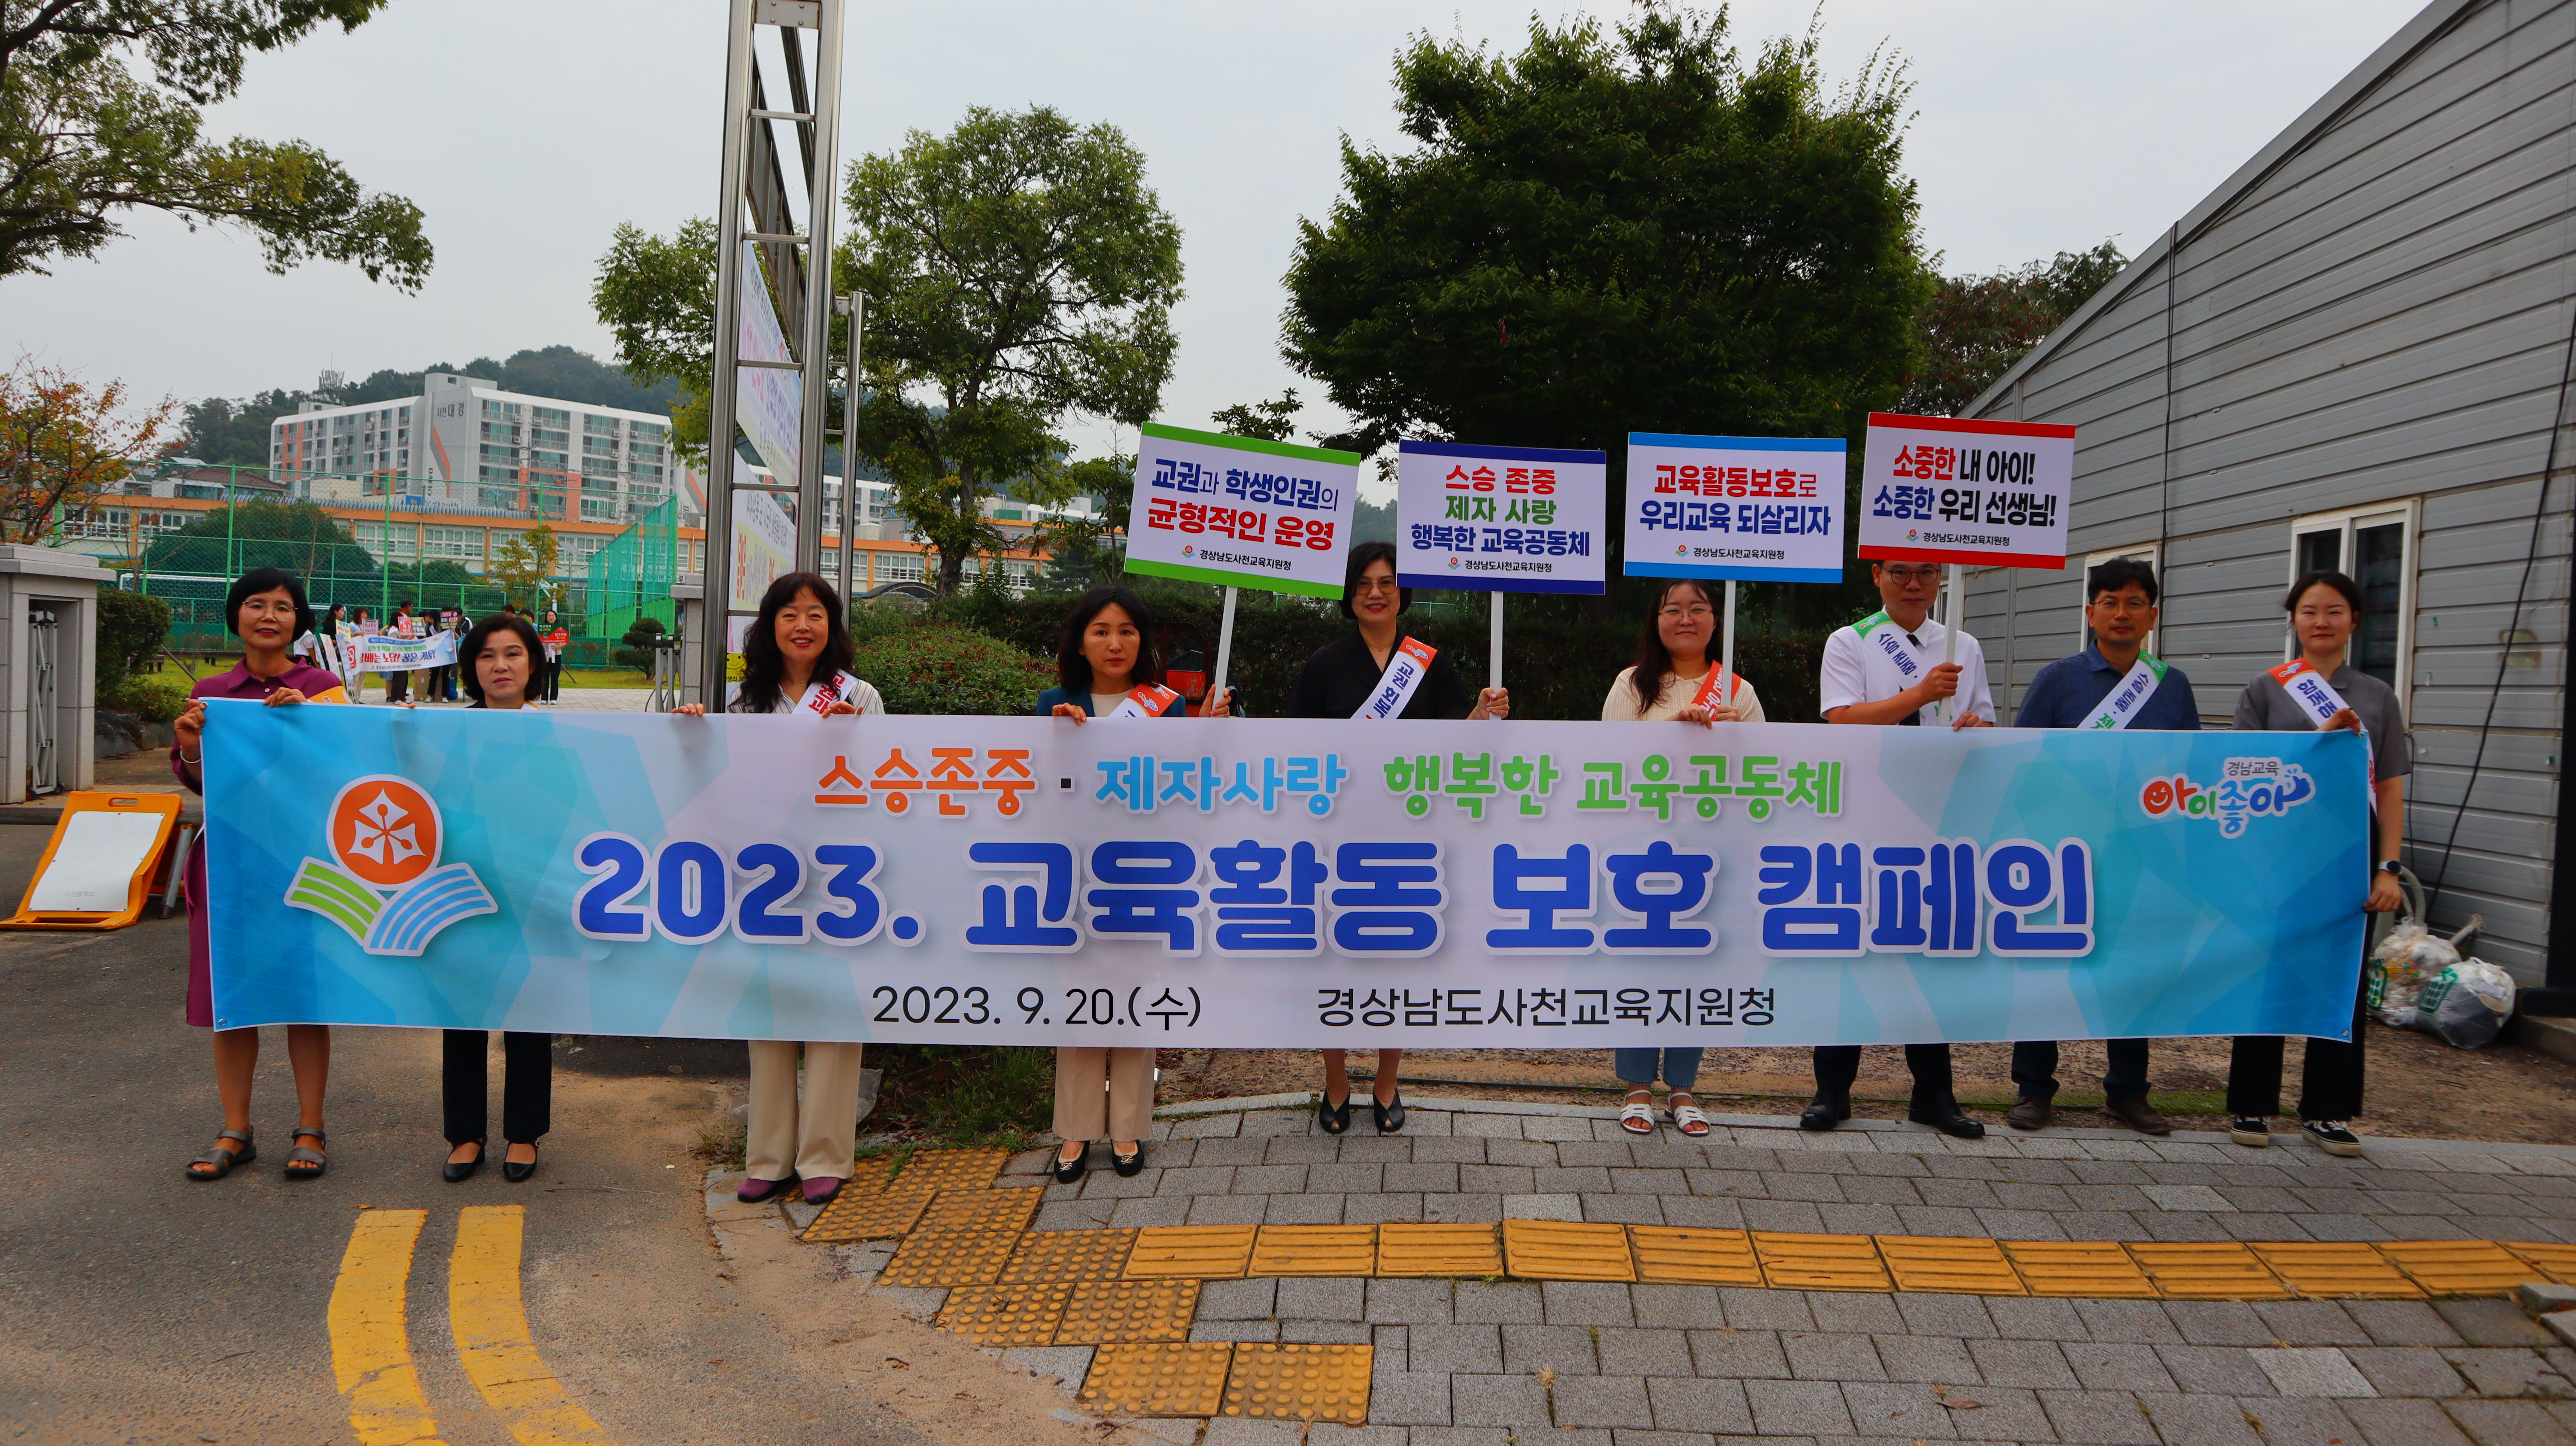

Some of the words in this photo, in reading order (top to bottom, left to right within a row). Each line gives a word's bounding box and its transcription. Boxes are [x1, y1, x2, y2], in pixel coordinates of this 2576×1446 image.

[436, 407, 447, 418] 사천
[1446, 465, 1495, 491] 스승
[1506, 468, 1555, 494] 존중
[1655, 465, 1817, 497] 교육활동보호로
[1893, 445, 1956, 480] 소중한
[1960, 450, 1981, 482] 내
[1987, 451, 2035, 485] 아이!
[1152, 459, 1219, 495] 교권과
[1226, 469, 1338, 511] 학생인권의
[1446, 496, 1496, 522] 제자
[1505, 499, 1556, 525] 사랑
[1640, 501, 1730, 533] 우리교육
[1738, 505, 1831, 535] 되살리자
[1874, 485, 1935, 520] 소중한
[1939, 489, 1980, 523] 우리
[1986, 492, 2057, 527] 선생님!
[1148, 498, 1267, 542] 균형적인
[1275, 516, 1334, 550] 운영
[1412, 524, 1476, 552] 행복한
[1482, 529, 1589, 556] 교육공동체
[1923, 533, 2009, 546] 경상남도사천교육지원청
[1200, 550, 1291, 570] 경상남도사천교육지원청
[1464, 559, 1552, 573] 경상남도사천교육지원청
[1694, 547, 1784, 561] 경상남도사천교육지원청
[383, 653, 401, 663] 노답!
[402, 653, 418, 662] 꿈은
[419, 649, 436, 661] 키움!
[1878, 633, 1901, 655] 스승
[1892, 650, 1917, 676] 존중
[1392, 661, 1415, 690] 교권
[2131, 673, 2149, 694] 스승
[1373, 686, 1400, 719] 회복
[2114, 688, 2137, 713] 존중
[815, 748, 1034, 815] 스승존중
[1096, 754, 1346, 814] 제자사랑
[1385, 753, 1557, 817] 행복한
[1578, 756, 1840, 819] 교육공동체
[2228, 761, 2279, 776] 경남교육
[2143, 776, 2311, 834] 아이좋아
[580, 838, 918, 938] 2023.
[967, 840, 1441, 950] 교육활동
[1487, 841, 1712, 947] 보호
[1759, 843, 2087, 949] 캠페인
[873, 986, 1000, 1024] 2023.
[1017, 987, 1050, 1024] 9.
[1066, 987, 1200, 1030] 20.(수)
[1318, 988, 1774, 1026] 경상남도사천교육지원청
